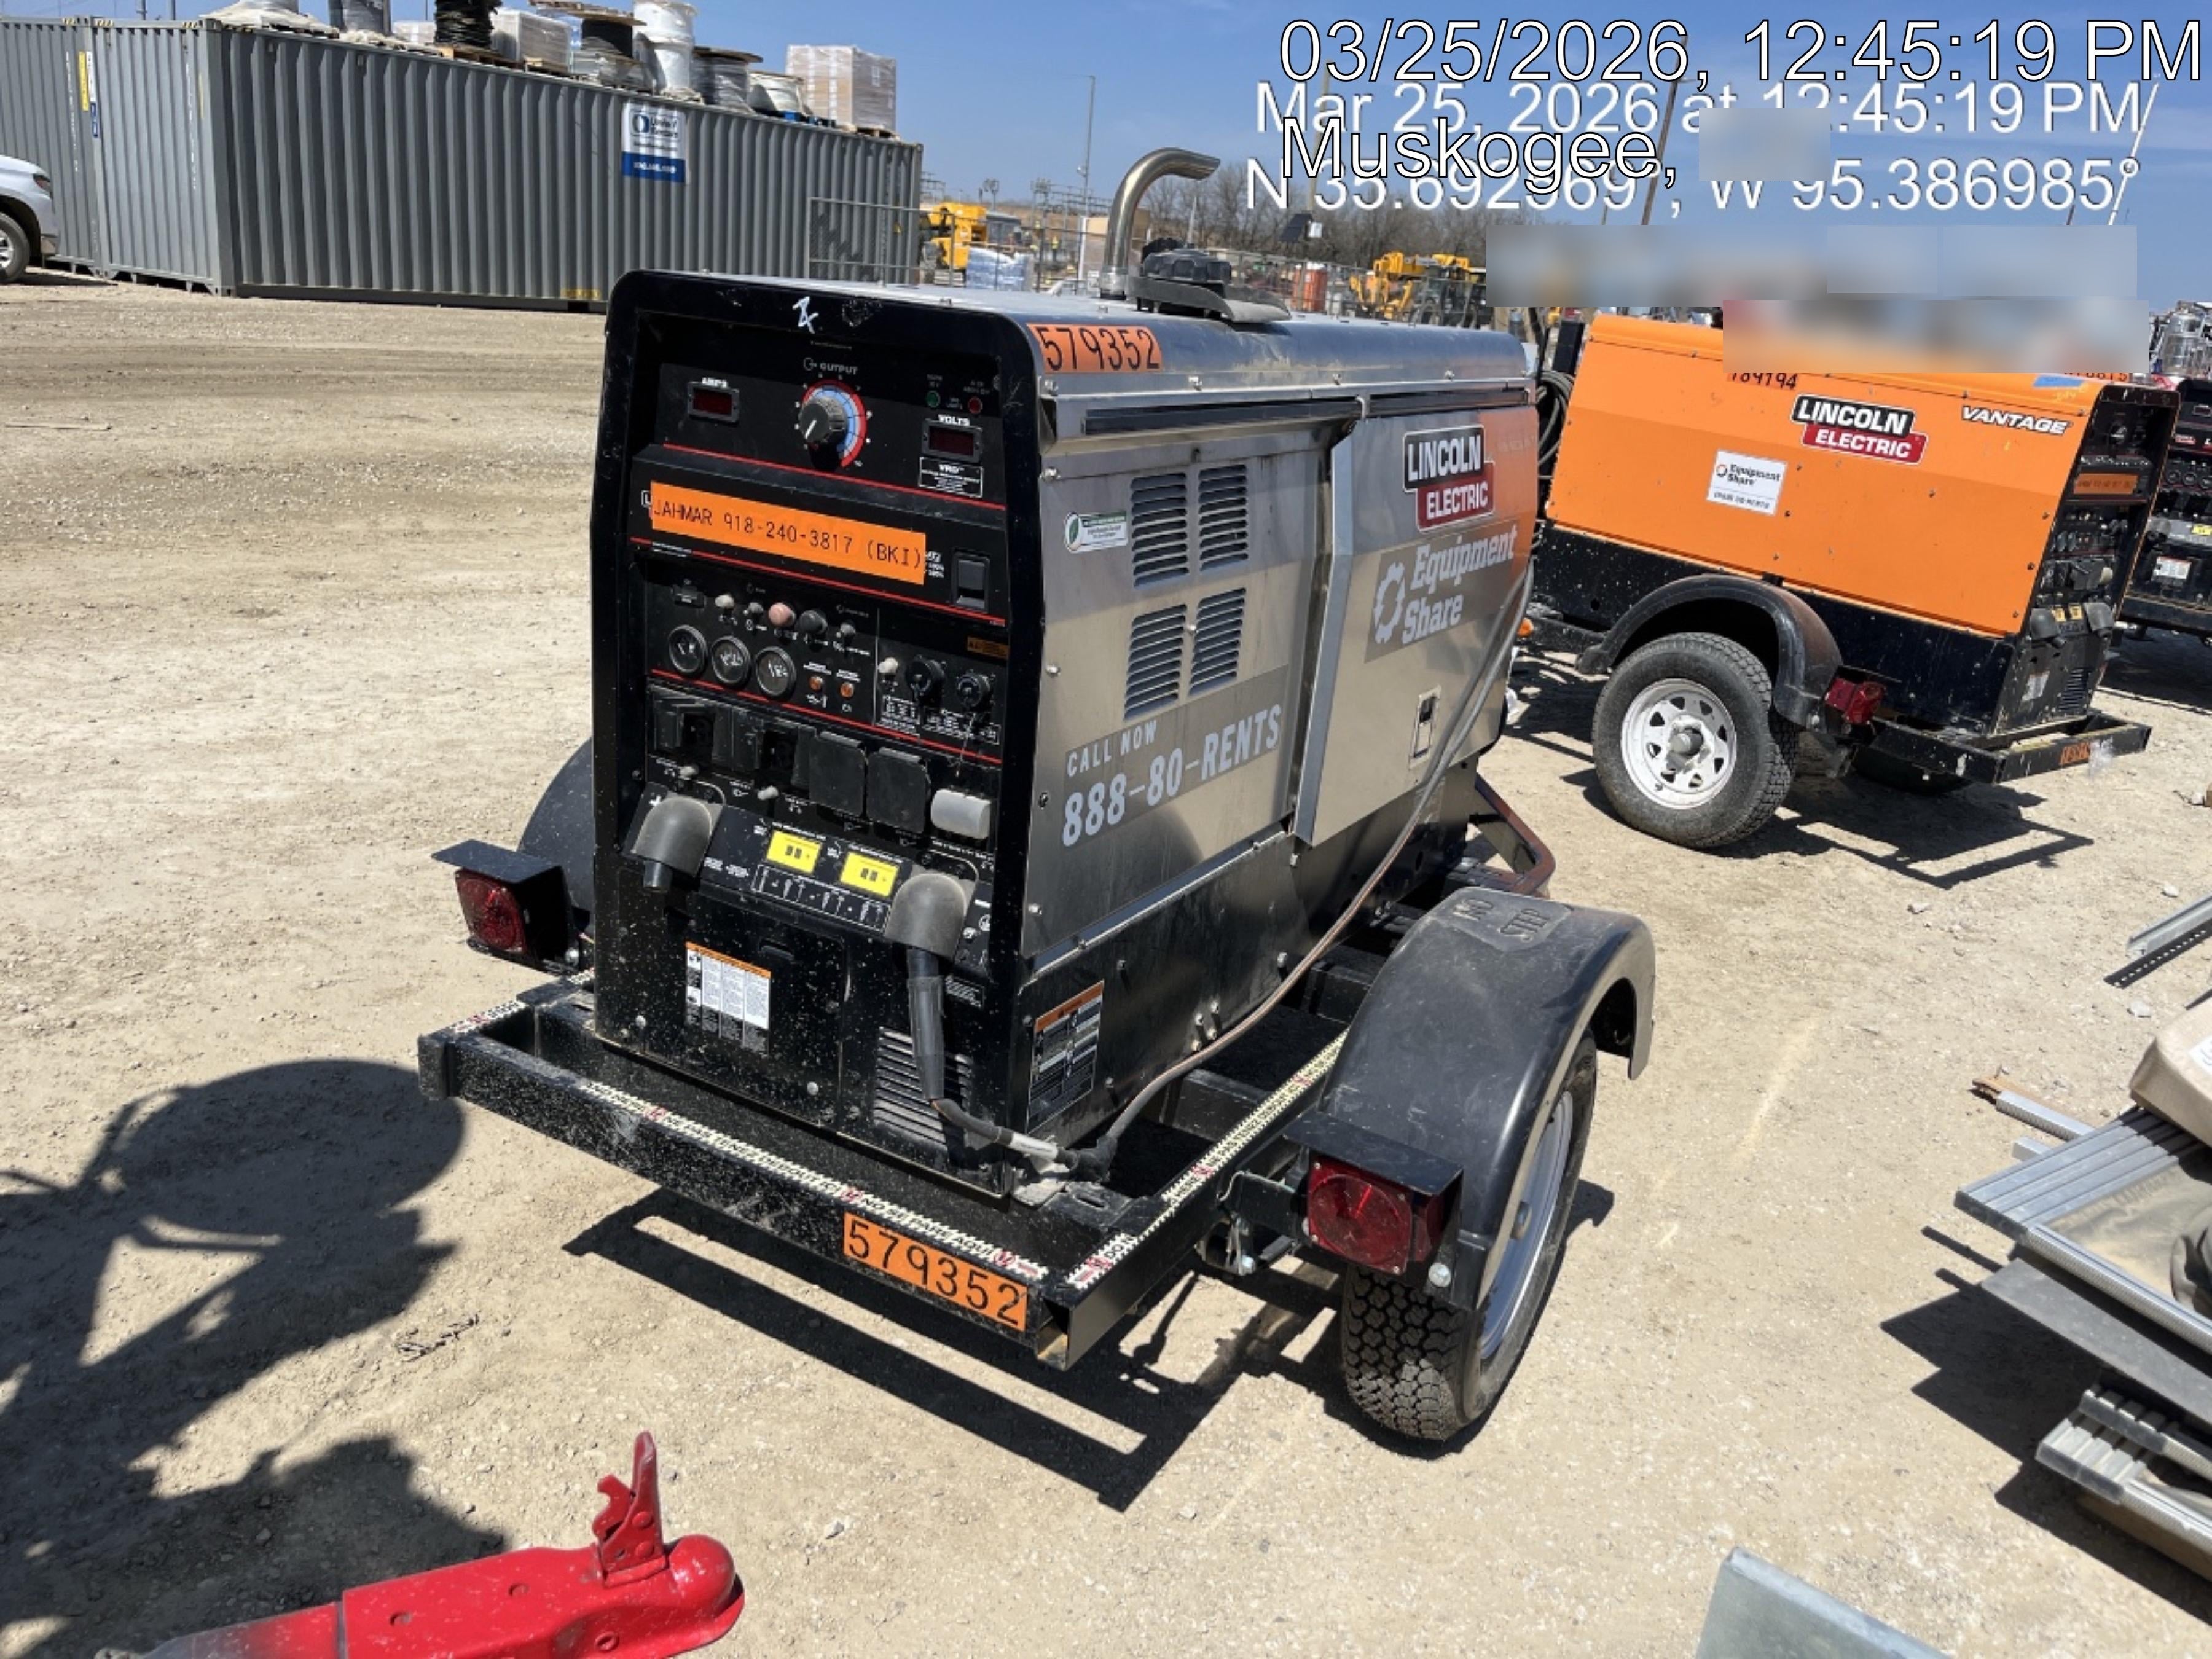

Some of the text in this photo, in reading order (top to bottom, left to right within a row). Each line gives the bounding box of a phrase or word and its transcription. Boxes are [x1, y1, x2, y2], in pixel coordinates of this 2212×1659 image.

[1035, 326, 1160, 371] 579352
[1798, 399, 1907, 434] LINCOLN
[1408, 435, 1481, 482] LINCOLN
[1815, 428, 1912, 458] ELECTRIC
[1426, 481, 1488, 520] ELECTRIC
[724, 512, 853, 554] 918-240-3817
[867, 539, 921, 569] (BKI)
[1410, 525, 1518, 594] Equipment
[1402, 594, 1464, 645] Share
[1067, 720, 1157, 777] CALL NOW
[1062, 704, 1282, 847] 888-80-RENTS
[849, 1219, 1019, 1326] 579352
